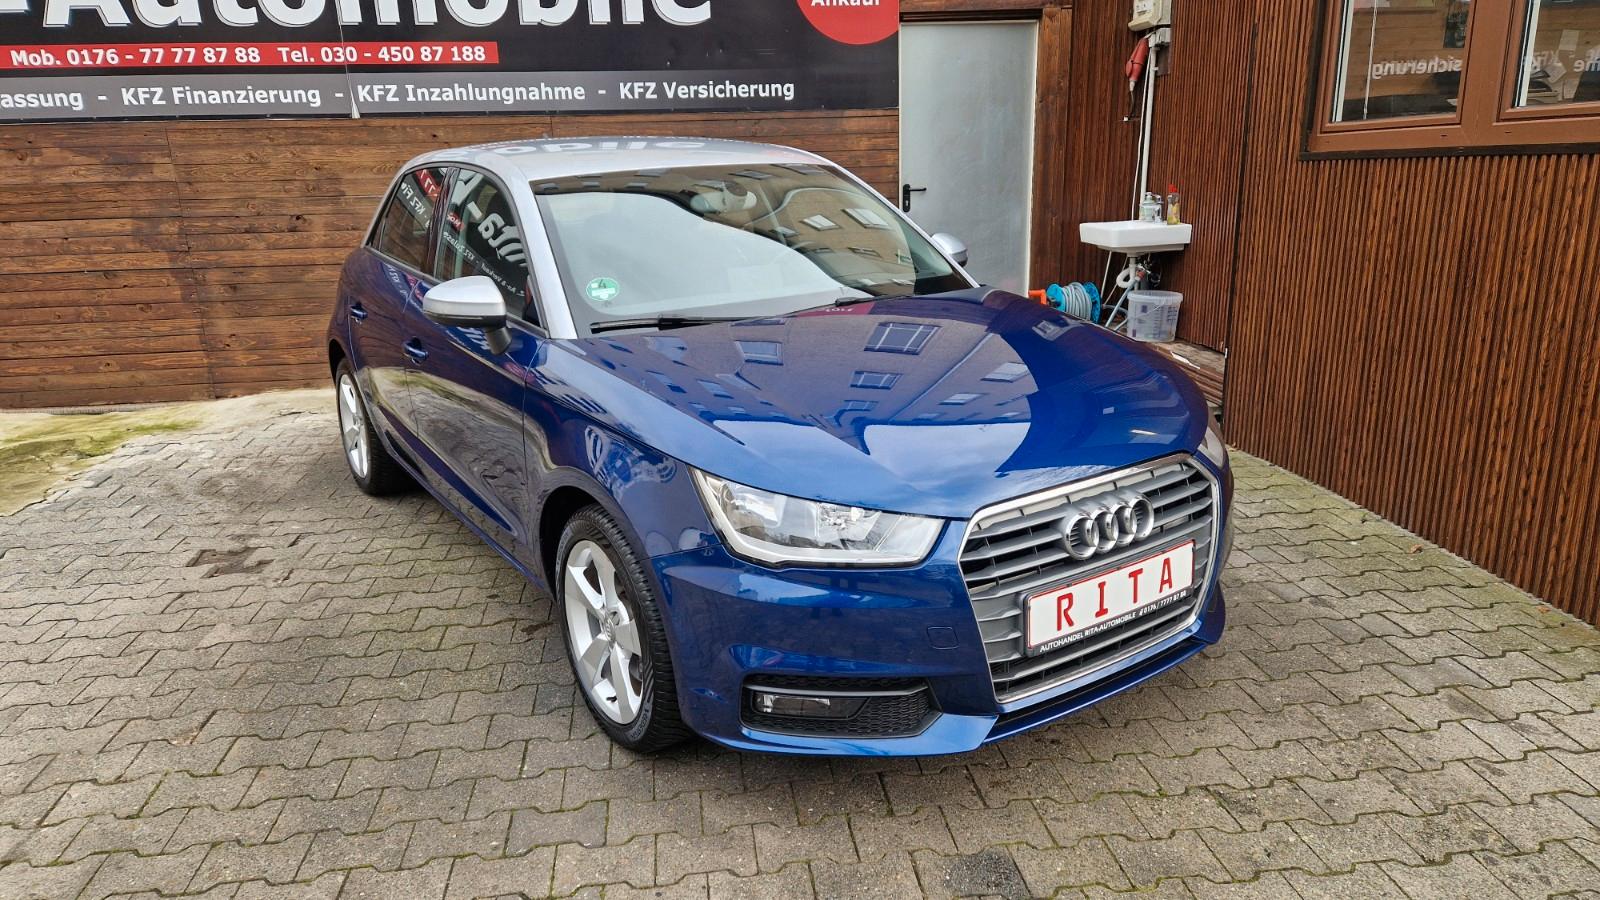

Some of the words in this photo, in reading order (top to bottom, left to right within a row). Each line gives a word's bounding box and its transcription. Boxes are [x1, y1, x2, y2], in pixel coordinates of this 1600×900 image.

[11, 49, 61, 66] Mob.
[67, 48, 119, 66] 0176
[139, 47, 164, 64] 77
[171, 47, 196, 63] 77
[203, 47, 228, 63] 87
[235, 46, 261, 63] 88
[277, 46, 315, 63] Tel.
[321, 46, 358, 62] 030
[377, 46, 414, 62] 450
[420, 45, 443, 62] 87
[450, 45, 486, 62] 188
[0, 91, 84, 111] assung
[121, 87, 167, 106] KFZ
[172, 85, 322, 108] Finanzierung
[357, 84, 400, 102] KFZ
[405, 81, 586, 105] Inzahlungnahme
[619, 81, 658, 100] KFZ
[662, 80, 795, 101] Versicherung
[1039, 632, 1084, 653] AUTOHANDEL
